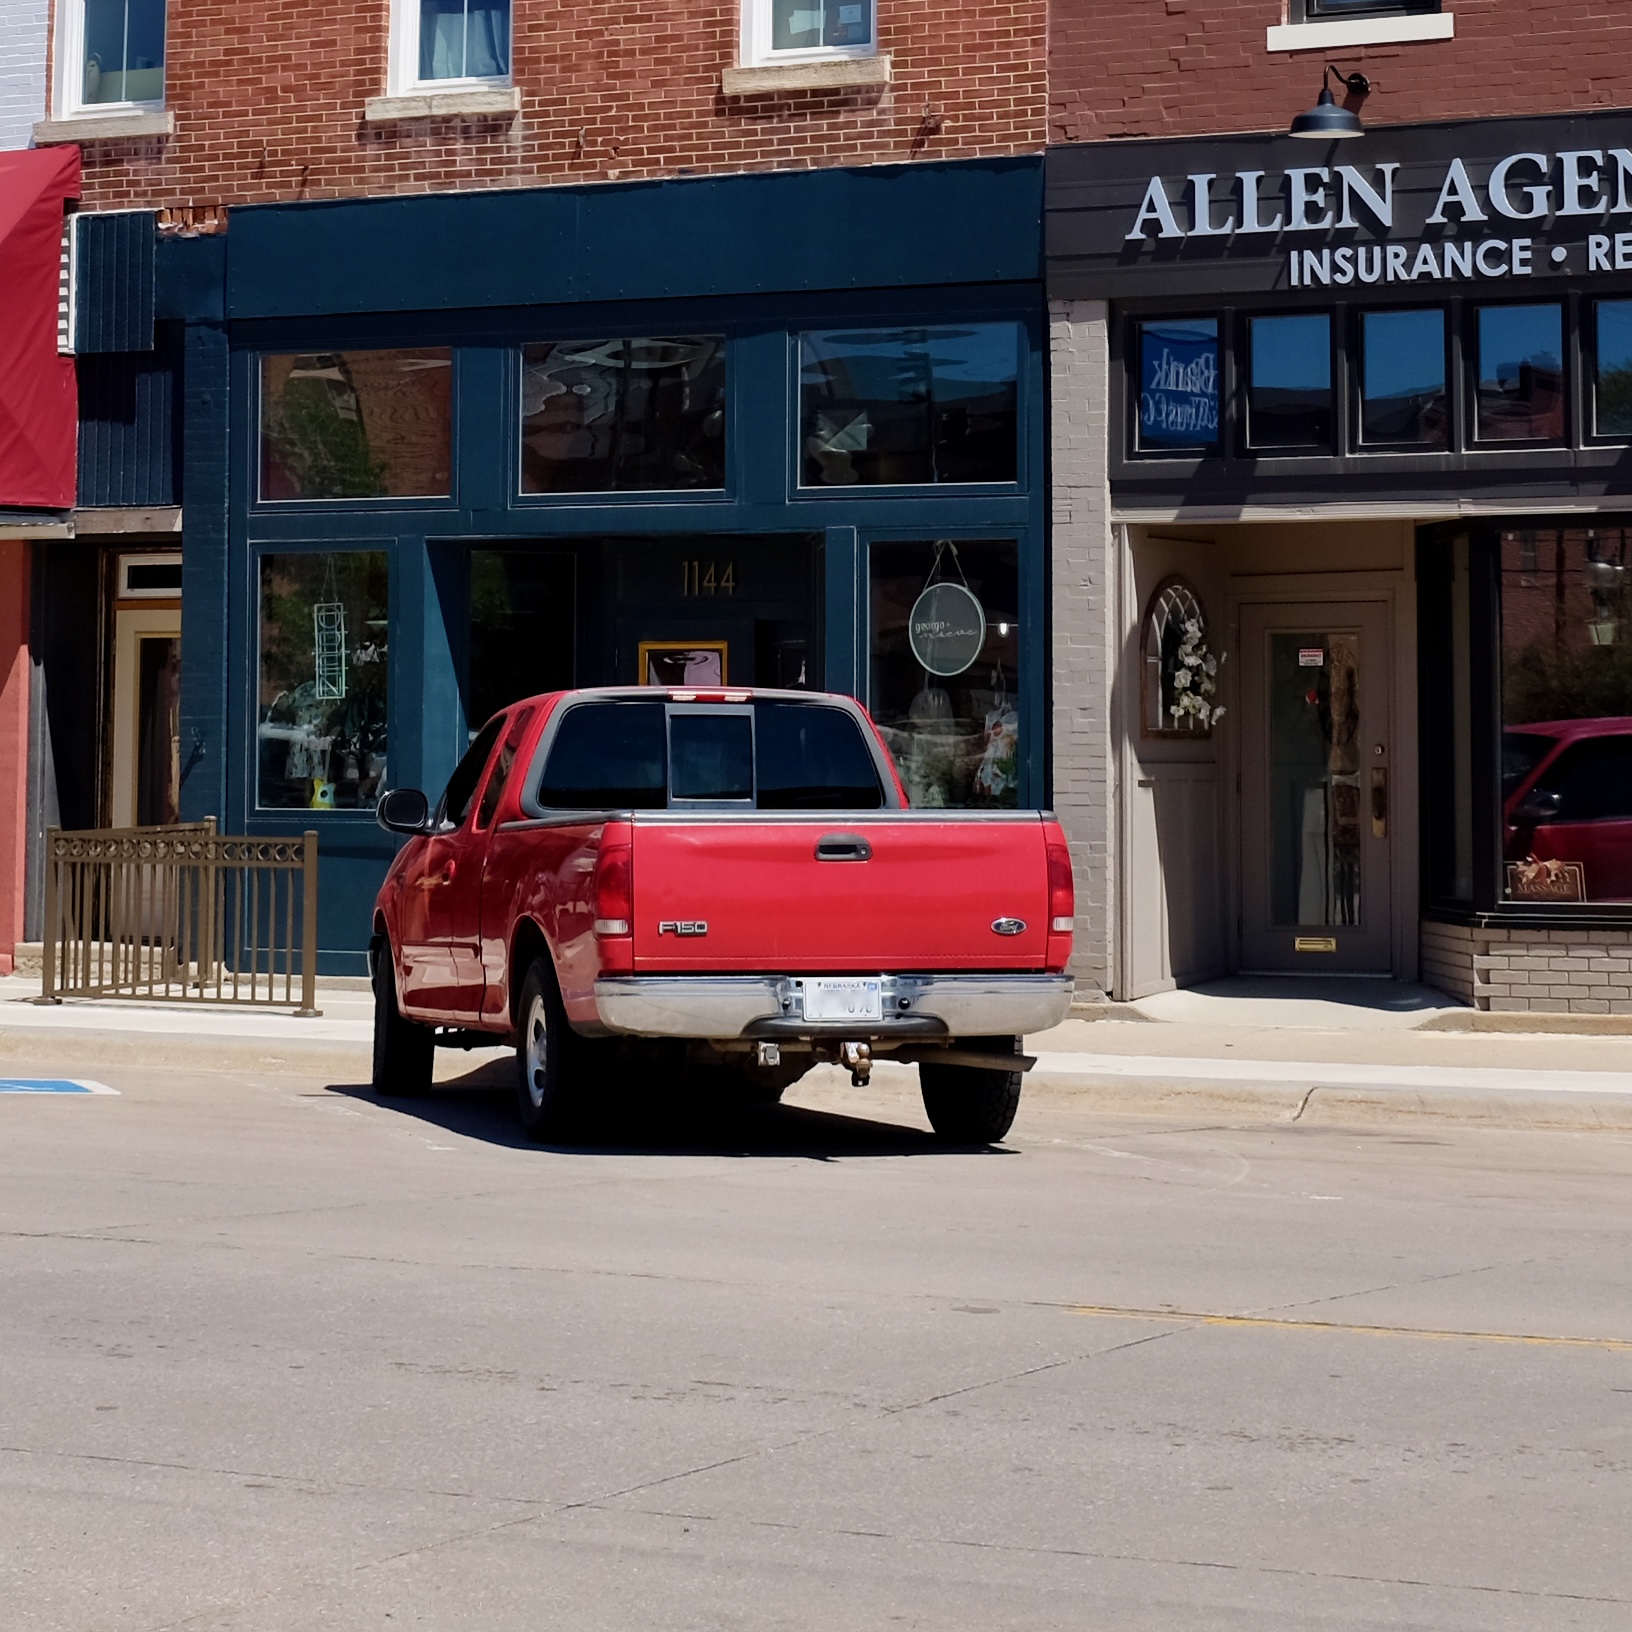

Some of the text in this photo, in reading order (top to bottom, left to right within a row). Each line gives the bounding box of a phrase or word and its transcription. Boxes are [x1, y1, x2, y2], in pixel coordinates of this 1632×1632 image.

[1125, 162, 1401, 240] ALLEN
[1290, 237, 1532, 286] INSURANCE
[682, 560, 736, 596] 1144
